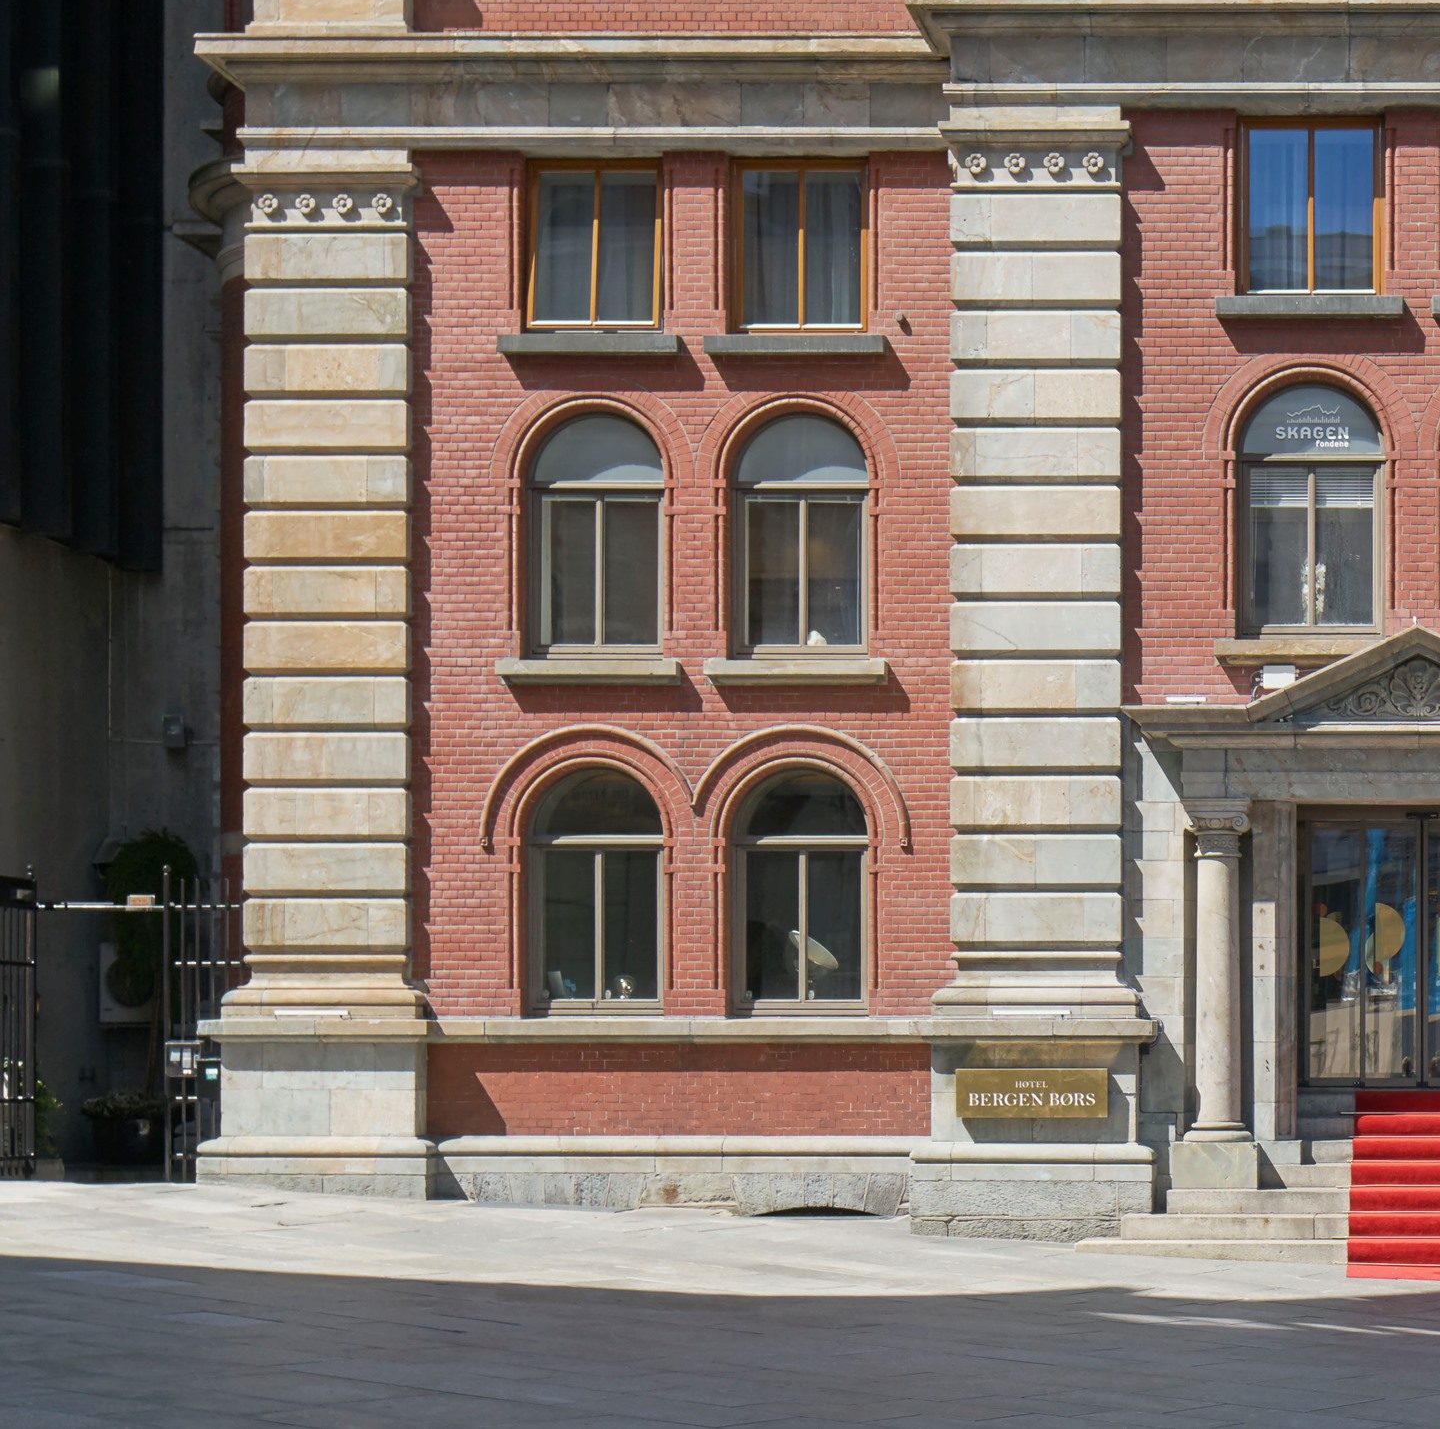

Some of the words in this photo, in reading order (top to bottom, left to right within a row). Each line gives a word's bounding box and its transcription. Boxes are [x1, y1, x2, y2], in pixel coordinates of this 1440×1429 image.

[1275, 426, 1349, 440] SKAGEN
[1315, 439, 1349, 448] fondene
[968, 1092, 1043, 1107] BERGEN
[1050, 1092, 1096, 1107] BØRS
